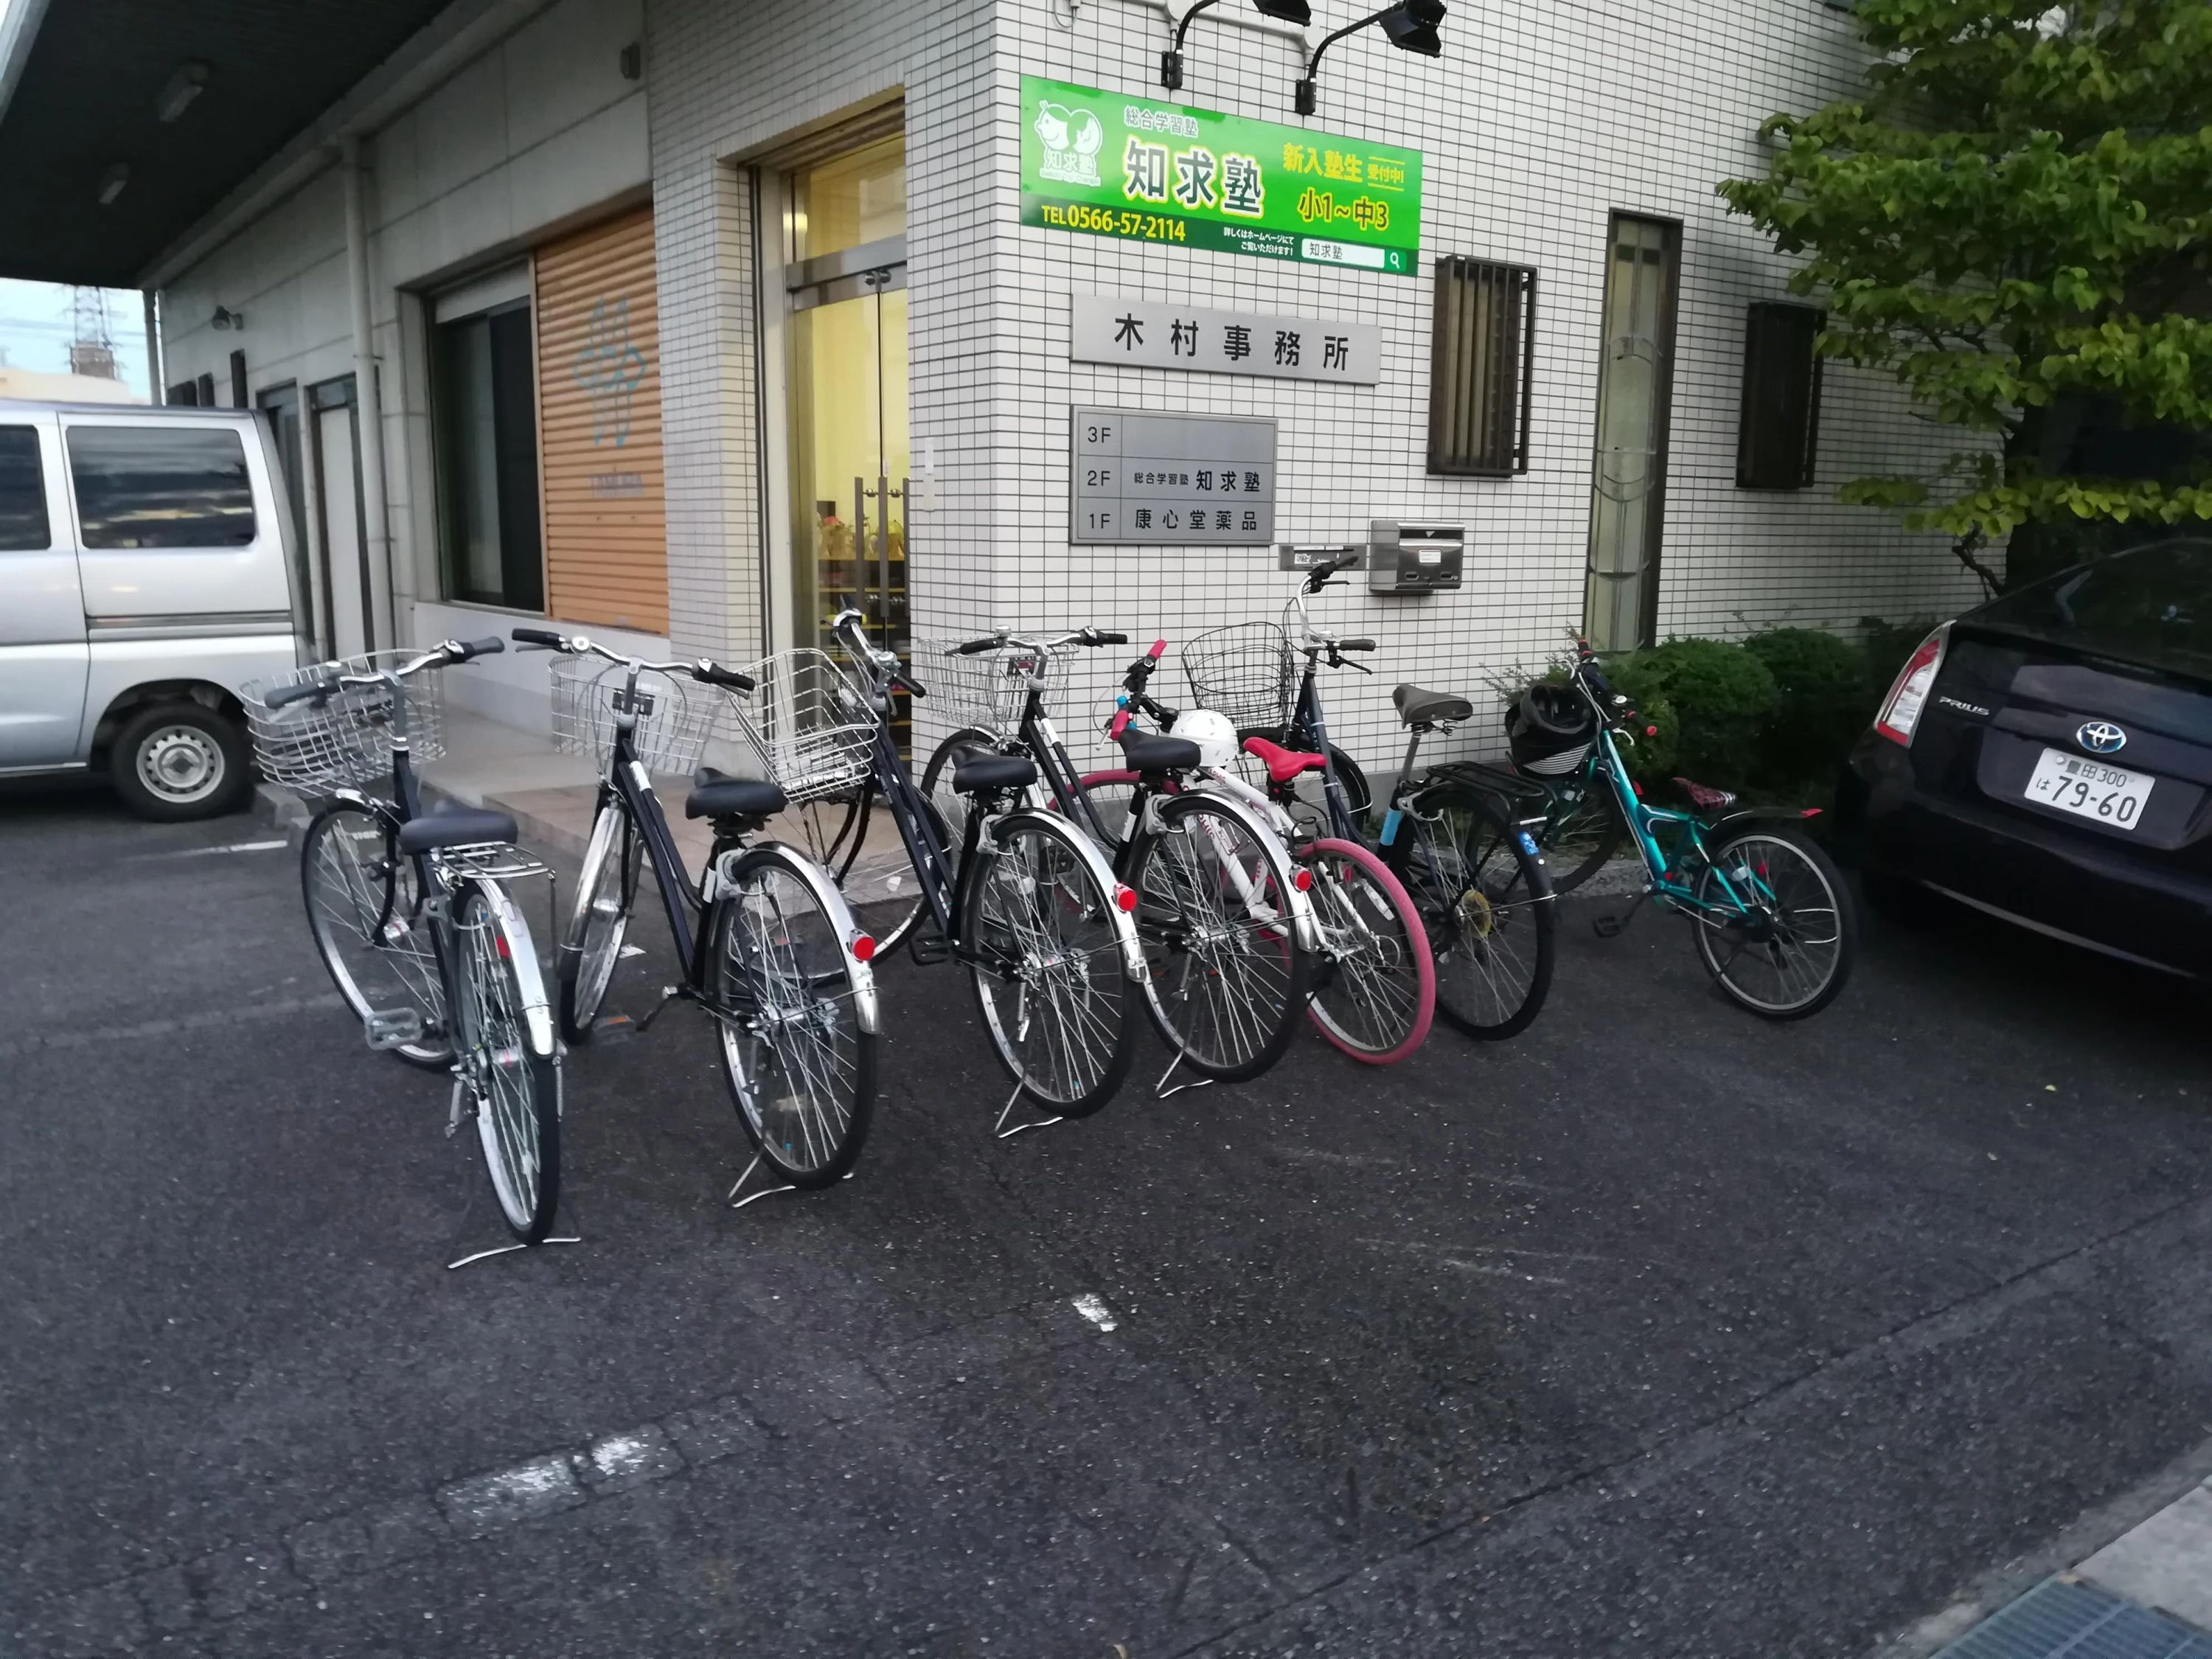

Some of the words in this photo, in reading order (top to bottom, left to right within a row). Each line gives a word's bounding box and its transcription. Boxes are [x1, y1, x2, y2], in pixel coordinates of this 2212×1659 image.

[1124, 105, 1198, 138] 総合学習塾
[1046, 148, 1095, 175] 知求塾
[1283, 142, 1363, 183] 新入塾生
[1126, 138, 1262, 214] 知求塾
[1041, 204, 1067, 225] TEL
[1068, 204, 1186, 241] 0566-57-2114
[1223, 226, 1295, 245] 詳しくはホームページにて
[1310, 242, 1343, 260] 知求塾
[1114, 313, 1349, 371] 木村事務所
[1087, 426, 1111, 443] 3F
[1087, 470, 1111, 487] 2F
[1196, 470, 1260, 492] 知求塾
[1088, 513, 1111, 529] 1F
[1135, 508, 1257, 531] 康心堂薬品
[1939, 696, 1989, 715] PRIUS
